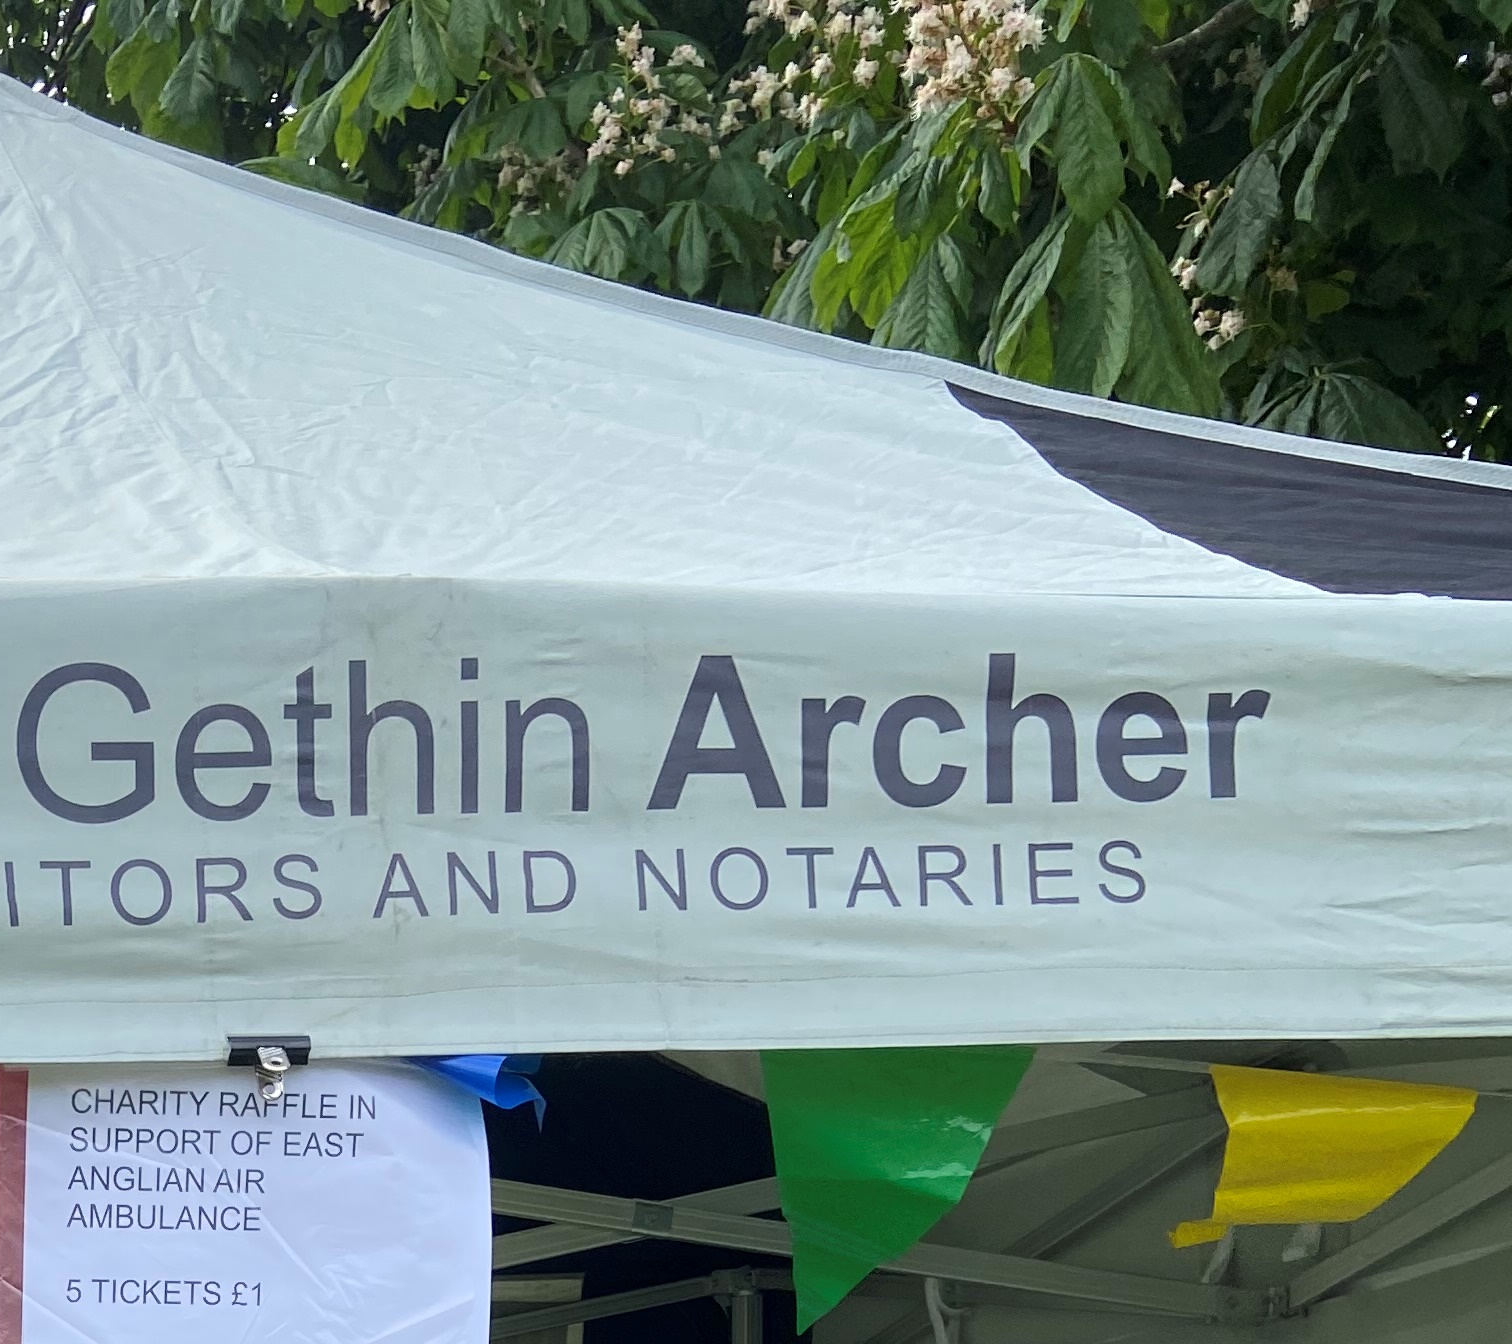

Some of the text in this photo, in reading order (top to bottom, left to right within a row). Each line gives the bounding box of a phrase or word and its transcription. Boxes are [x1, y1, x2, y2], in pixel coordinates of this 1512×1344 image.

[17, 656, 589, 824] Gethin
[645, 653, 1270, 809] Archer
[373, 849, 577, 918] AND
[638, 840, 1148, 911] NOTARIES
[71, 1088, 376, 1120] CHARITY RAFFLE IN
[69, 1127, 365, 1158] SUPPORT OF EAST
[67, 1166, 265, 1194] ANGLIAN AIR
[66, 1204, 262, 1231] AMBULANCE
[66, 1279, 262, 1307] 5 TICKETS £1
